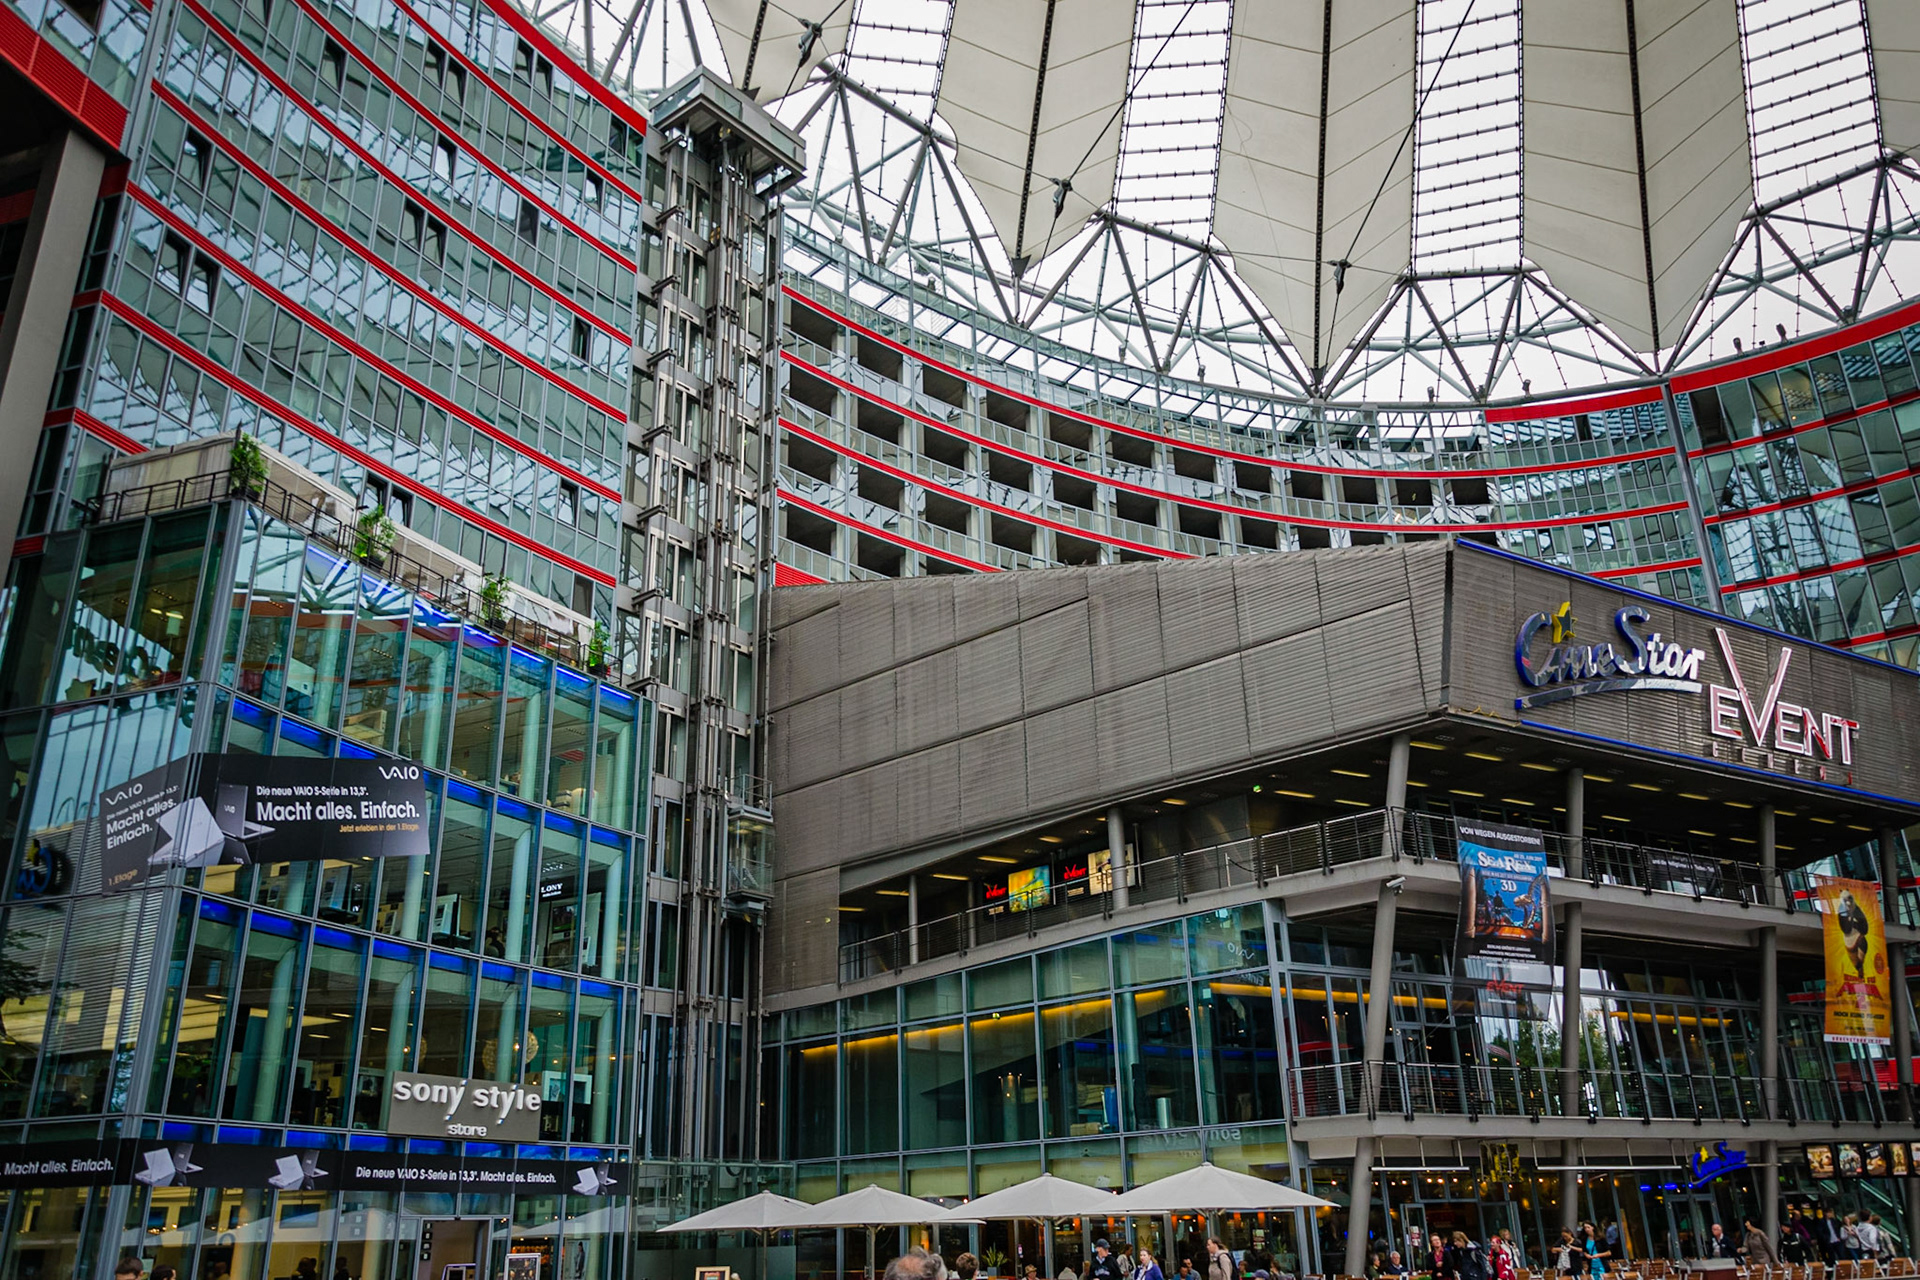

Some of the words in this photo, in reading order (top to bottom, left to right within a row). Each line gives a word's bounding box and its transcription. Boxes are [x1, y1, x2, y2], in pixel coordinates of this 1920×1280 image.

[1516, 605, 1706, 687] CineStar
[1710, 627, 1860, 765] EVENT
[378, 766, 420, 780] VAIO
[105, 783, 143, 806] VAIO
[256, 785, 271, 796] Die
[271, 786, 293, 796] neue
[293, 786, 314, 796] VAIO
[314, 786, 340, 796] S-Serie
[341, 787, 349, 796] in
[106, 808, 145, 835] Macht
[146, 798, 177, 818] alles.
[256, 801, 312, 821] Macht
[315, 801, 357, 820] alles.
[360, 800, 420, 819] Einfach.
[106, 822, 153, 850] Einfach.
[1459, 826, 1474, 835] VON
[1474, 828, 1496, 838] WEGEN
[1500, 879, 1517, 892] 3D
[393, 1079, 469, 1121] sony
[472, 1083, 541, 1125] style
[447, 1123, 488, 1137] store
[4, 1161, 40, 1175] Macht
[40, 1160, 68, 1174] alles.
[71, 1158, 114, 1172] Einfach.
[356, 1166, 371, 1178] Die
[372, 1168, 395, 1179] neue
[397, 1168, 419, 1180] VAIO
[419, 1168, 448, 1180] S-Serie
[449, 1170, 457, 1181] in
[480, 1170, 506, 1182] Macht
[506, 1171, 526, 1183] ales.
[527, 1172, 557, 1184] Einfach.
